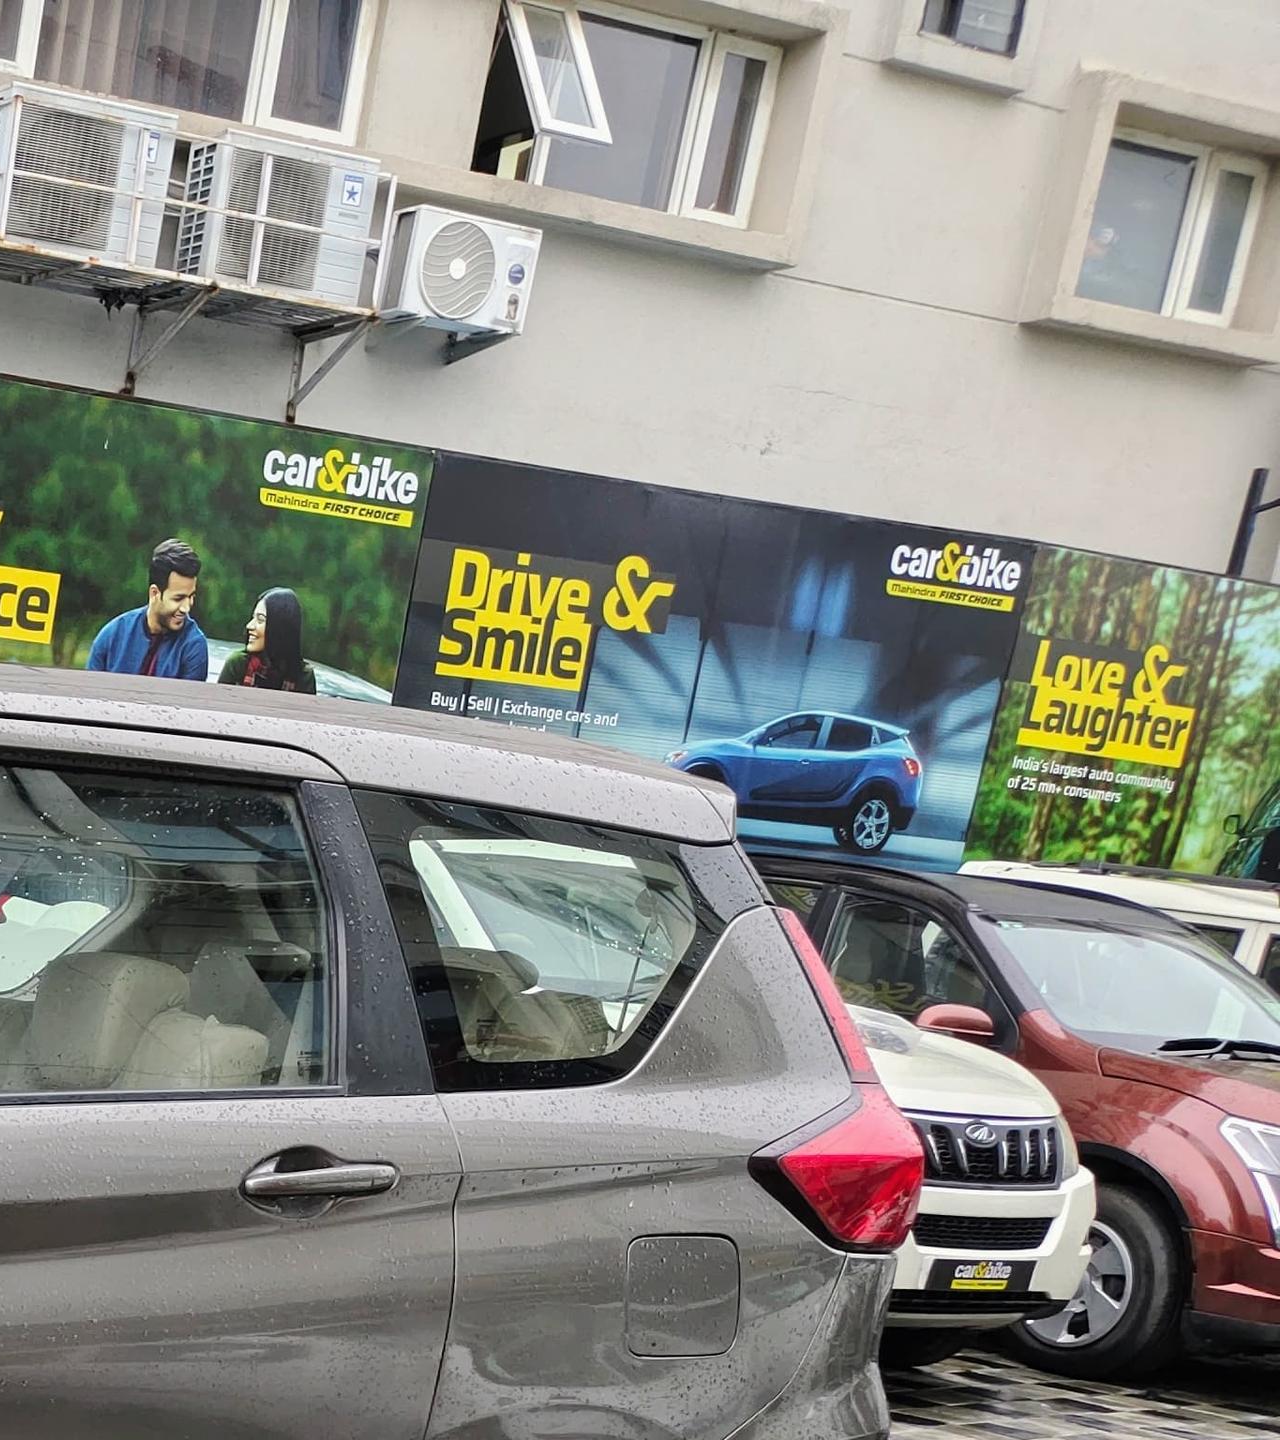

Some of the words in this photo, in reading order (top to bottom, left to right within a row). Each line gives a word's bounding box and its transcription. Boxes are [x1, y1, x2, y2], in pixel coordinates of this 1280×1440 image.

[263, 449, 418, 504] car&bike
[265, 492, 320, 510] Mahindra
[323, 502, 358, 516] FIRST
[358, 508, 400, 522] CHOICE
[446, 548, 591, 622] Drive
[603, 555, 675, 633] &
[890, 542, 1021, 591] car&bike
[891, 583, 936, 597] Mahindra
[938, 590, 969, 602] FIRST
[968, 594, 1003, 607] CHOICE
[439, 607, 582, 679] Smile
[1030, 639, 1126, 695] Love
[1132, 643, 1188, 704] &
[430, 691, 458, 711] Buy
[467, 696, 493, 712] Sell
[501, 700, 563, 722] Exchange
[565, 710, 590, 723] cars
[593, 712, 619, 727] and
[1022, 692, 1189, 751] Laughter
[1007, 775, 1020, 790] of
[1021, 777, 1037, 791] 25
[1063, 784, 1122, 803] consumers
[1012, 755, 1049, 773] India's
[1049, 761, 1089, 780] largest
[1088, 767, 1114, 783] auto
[1115, 772, 1175, 794] community
